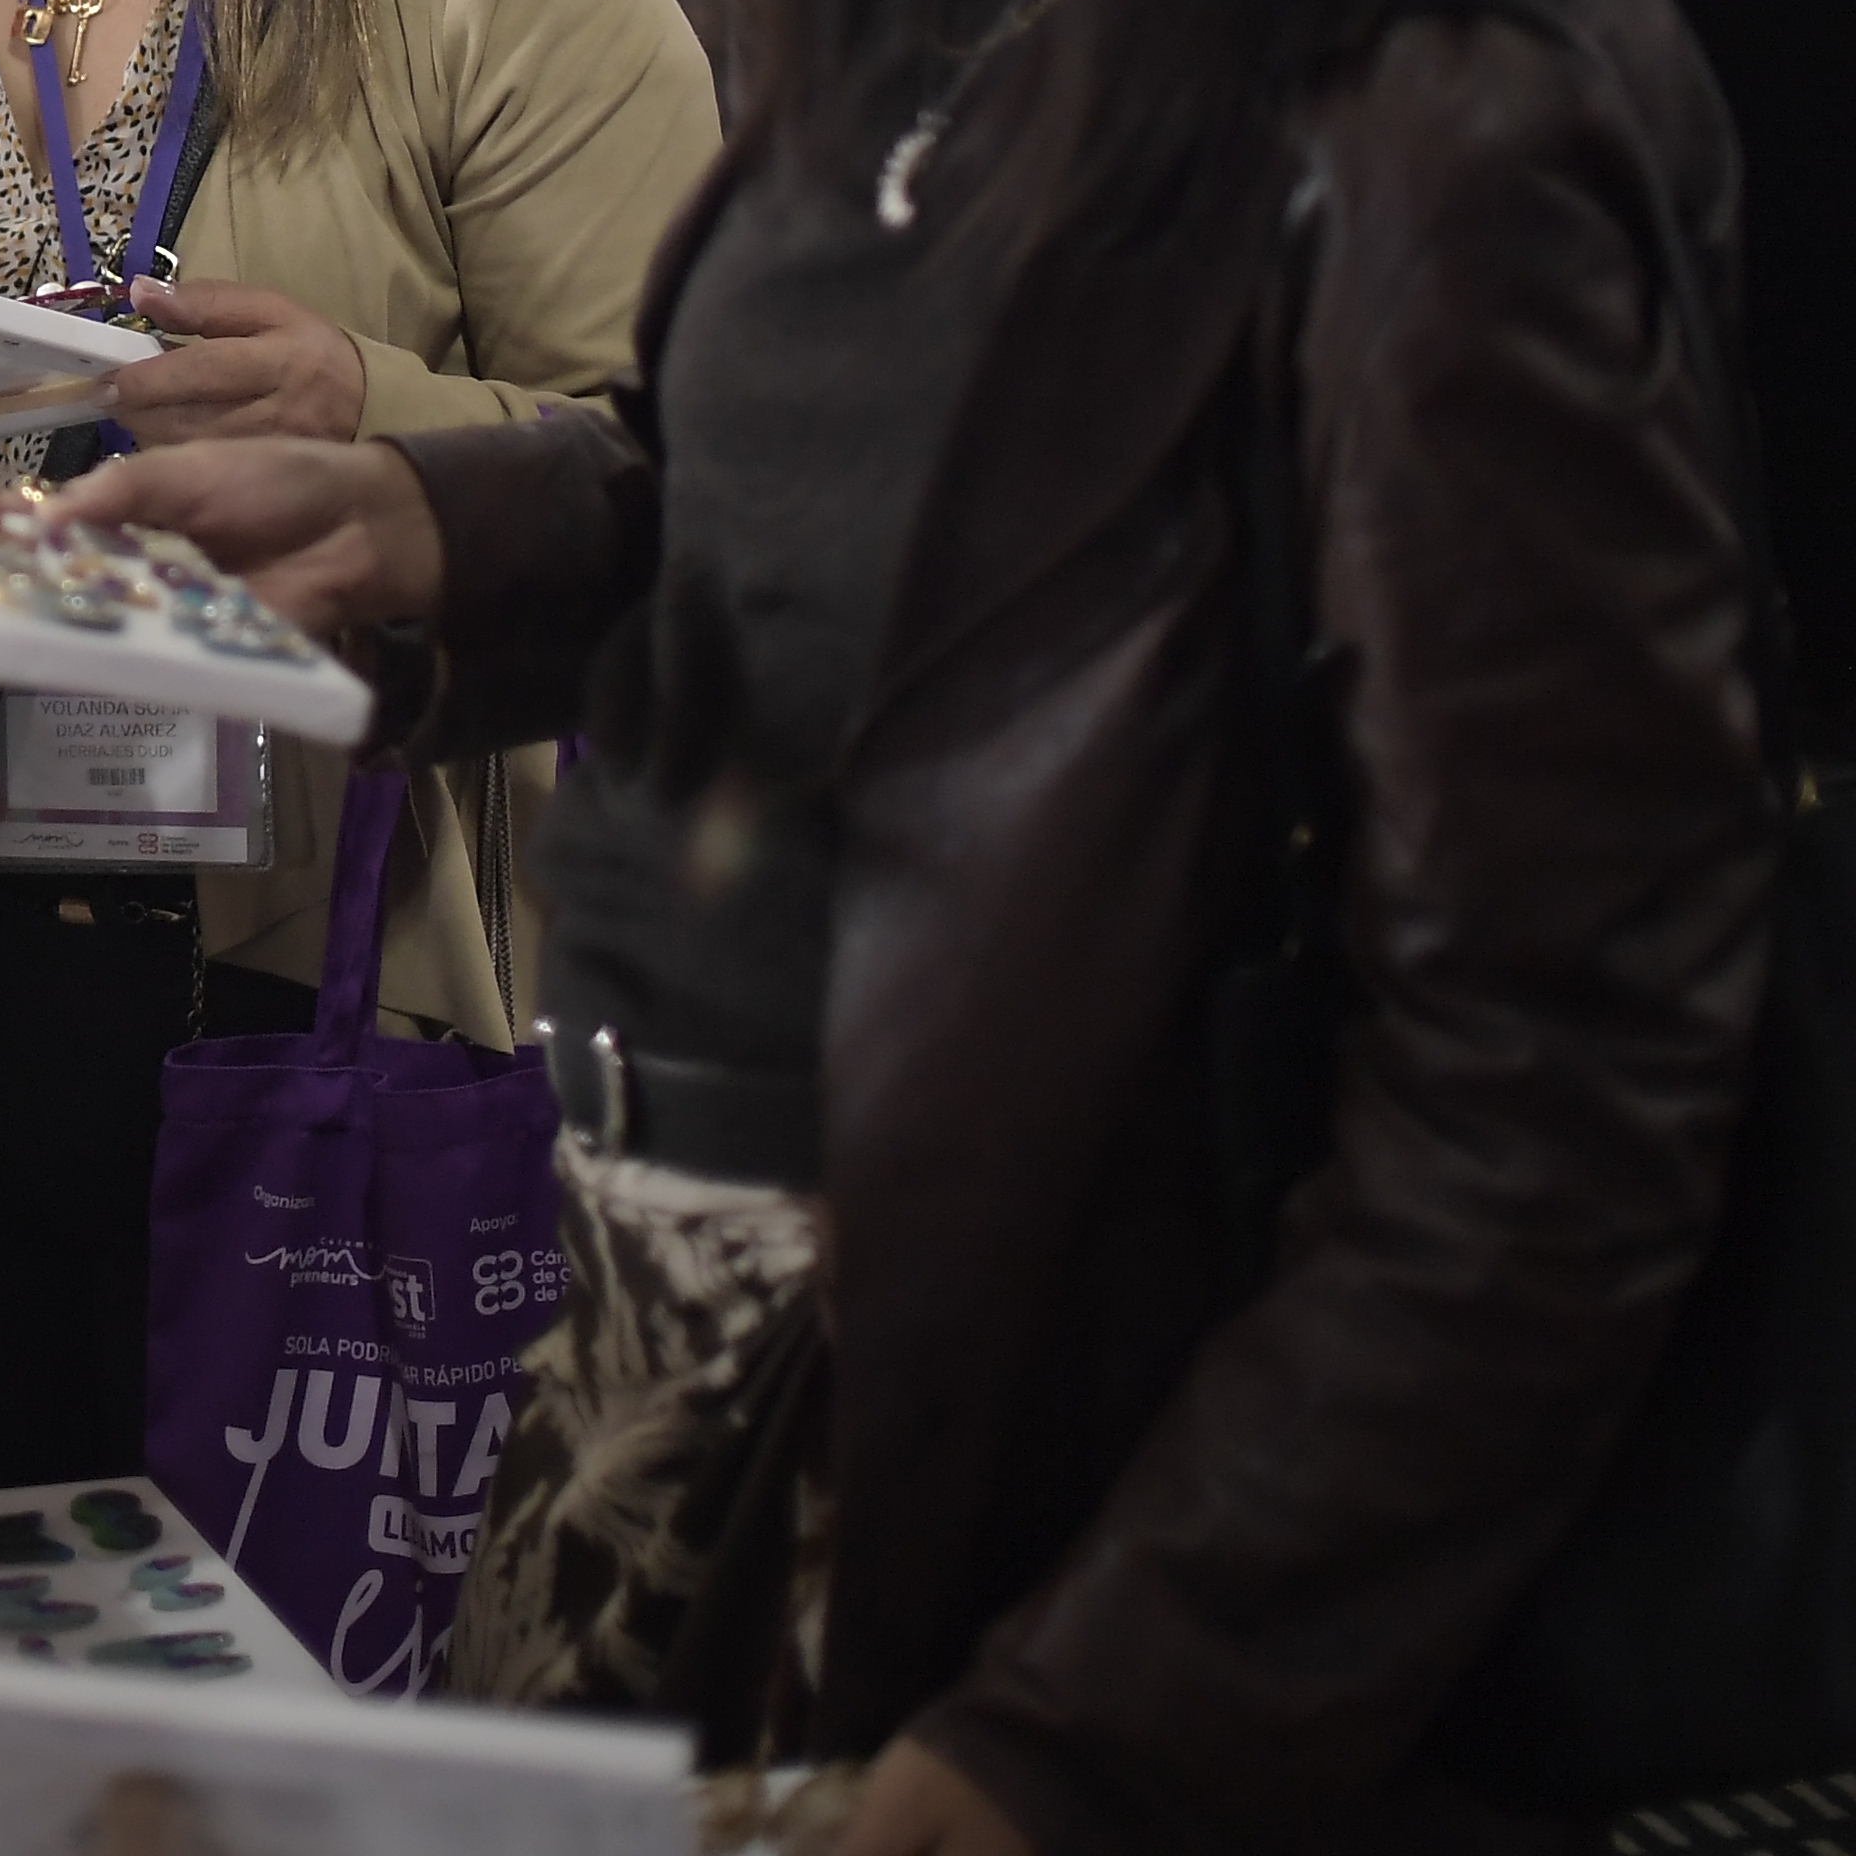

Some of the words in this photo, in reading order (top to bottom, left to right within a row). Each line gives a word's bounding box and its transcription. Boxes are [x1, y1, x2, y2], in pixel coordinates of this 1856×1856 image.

[40, 699, 129, 716] YOLANDA
[56, 723, 93, 738] DIAZ
[99, 723, 177, 738] ALVAREZ
[290, 1271, 360, 1289] preneurs
[533, 1267, 557, 1284] de
[534, 1285, 558, 1302] de
[284, 1335, 331, 1356] SOLA
[337, 1338, 395, 1364] PODR
[424, 1361, 495, 1386] RÁPIDO
